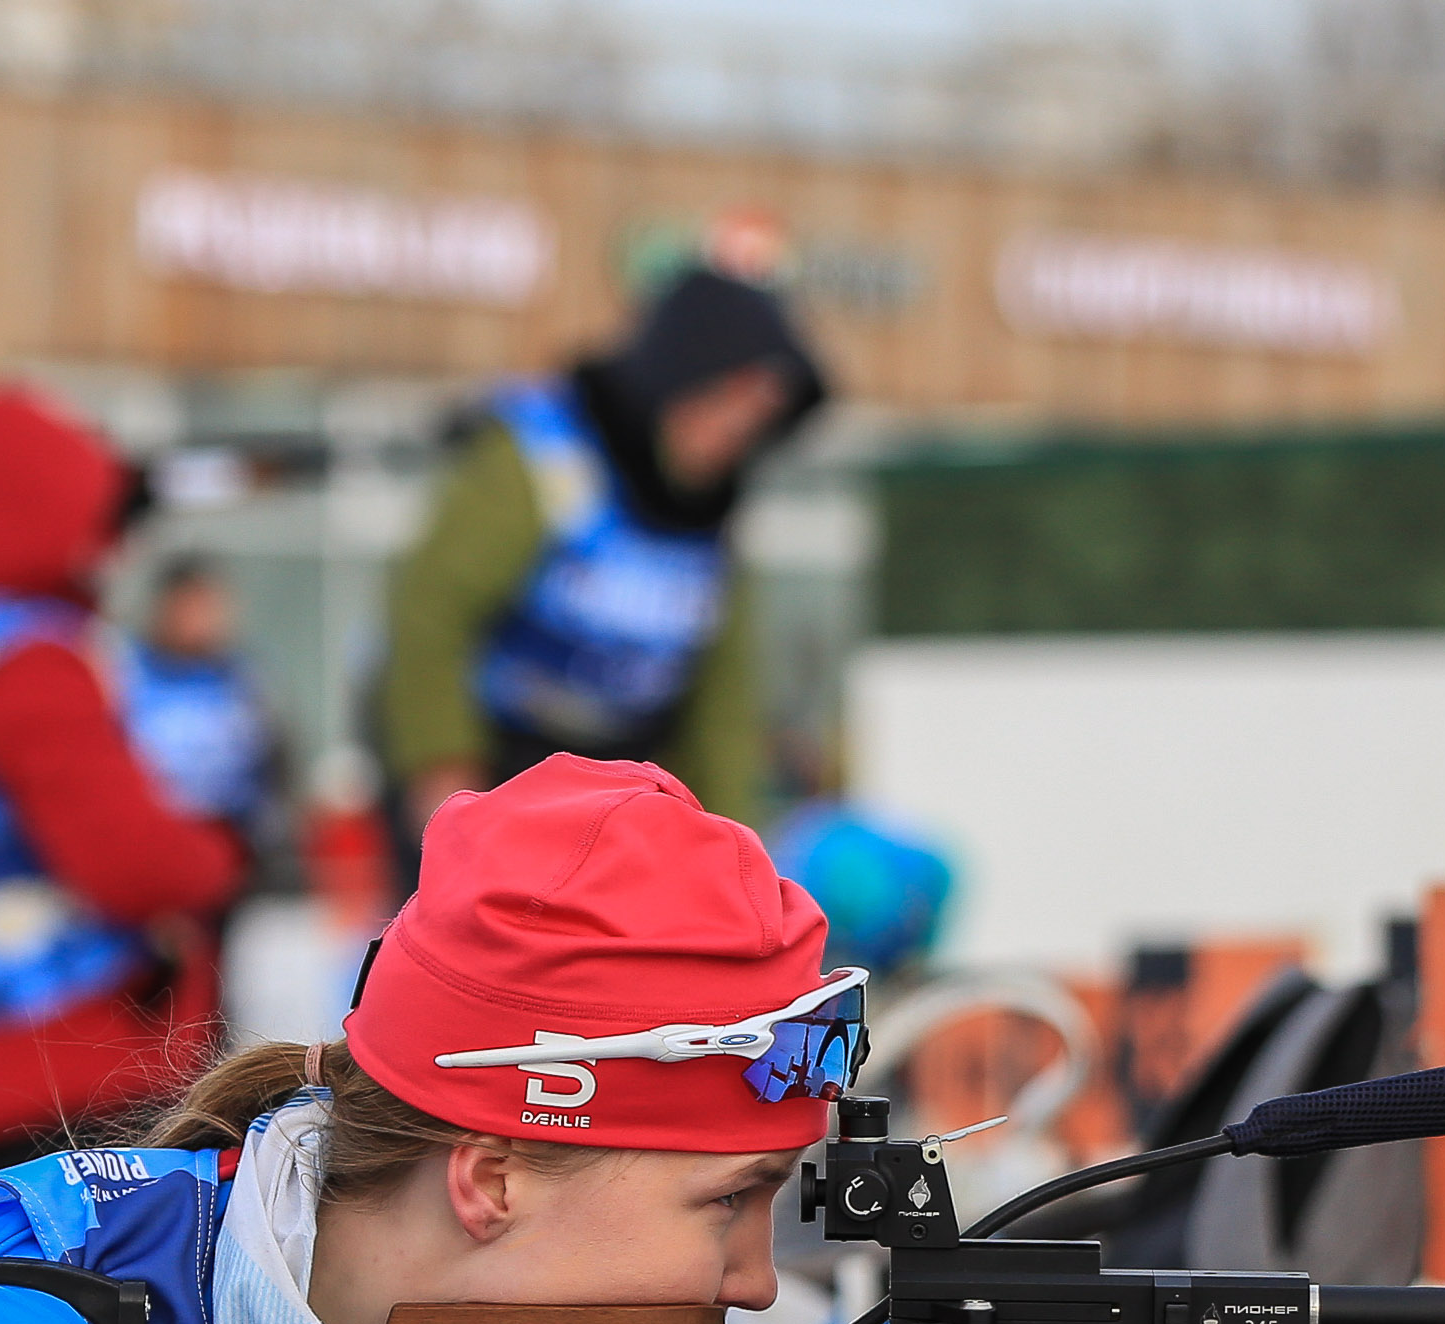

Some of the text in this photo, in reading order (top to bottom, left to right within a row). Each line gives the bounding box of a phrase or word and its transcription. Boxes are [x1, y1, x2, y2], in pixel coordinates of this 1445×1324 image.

[521, 1111, 591, 1128] DÆHLIE
[56, 1151, 150, 1186] PIONER
[1224, 1305, 1299, 1314] ПИОНЕР
